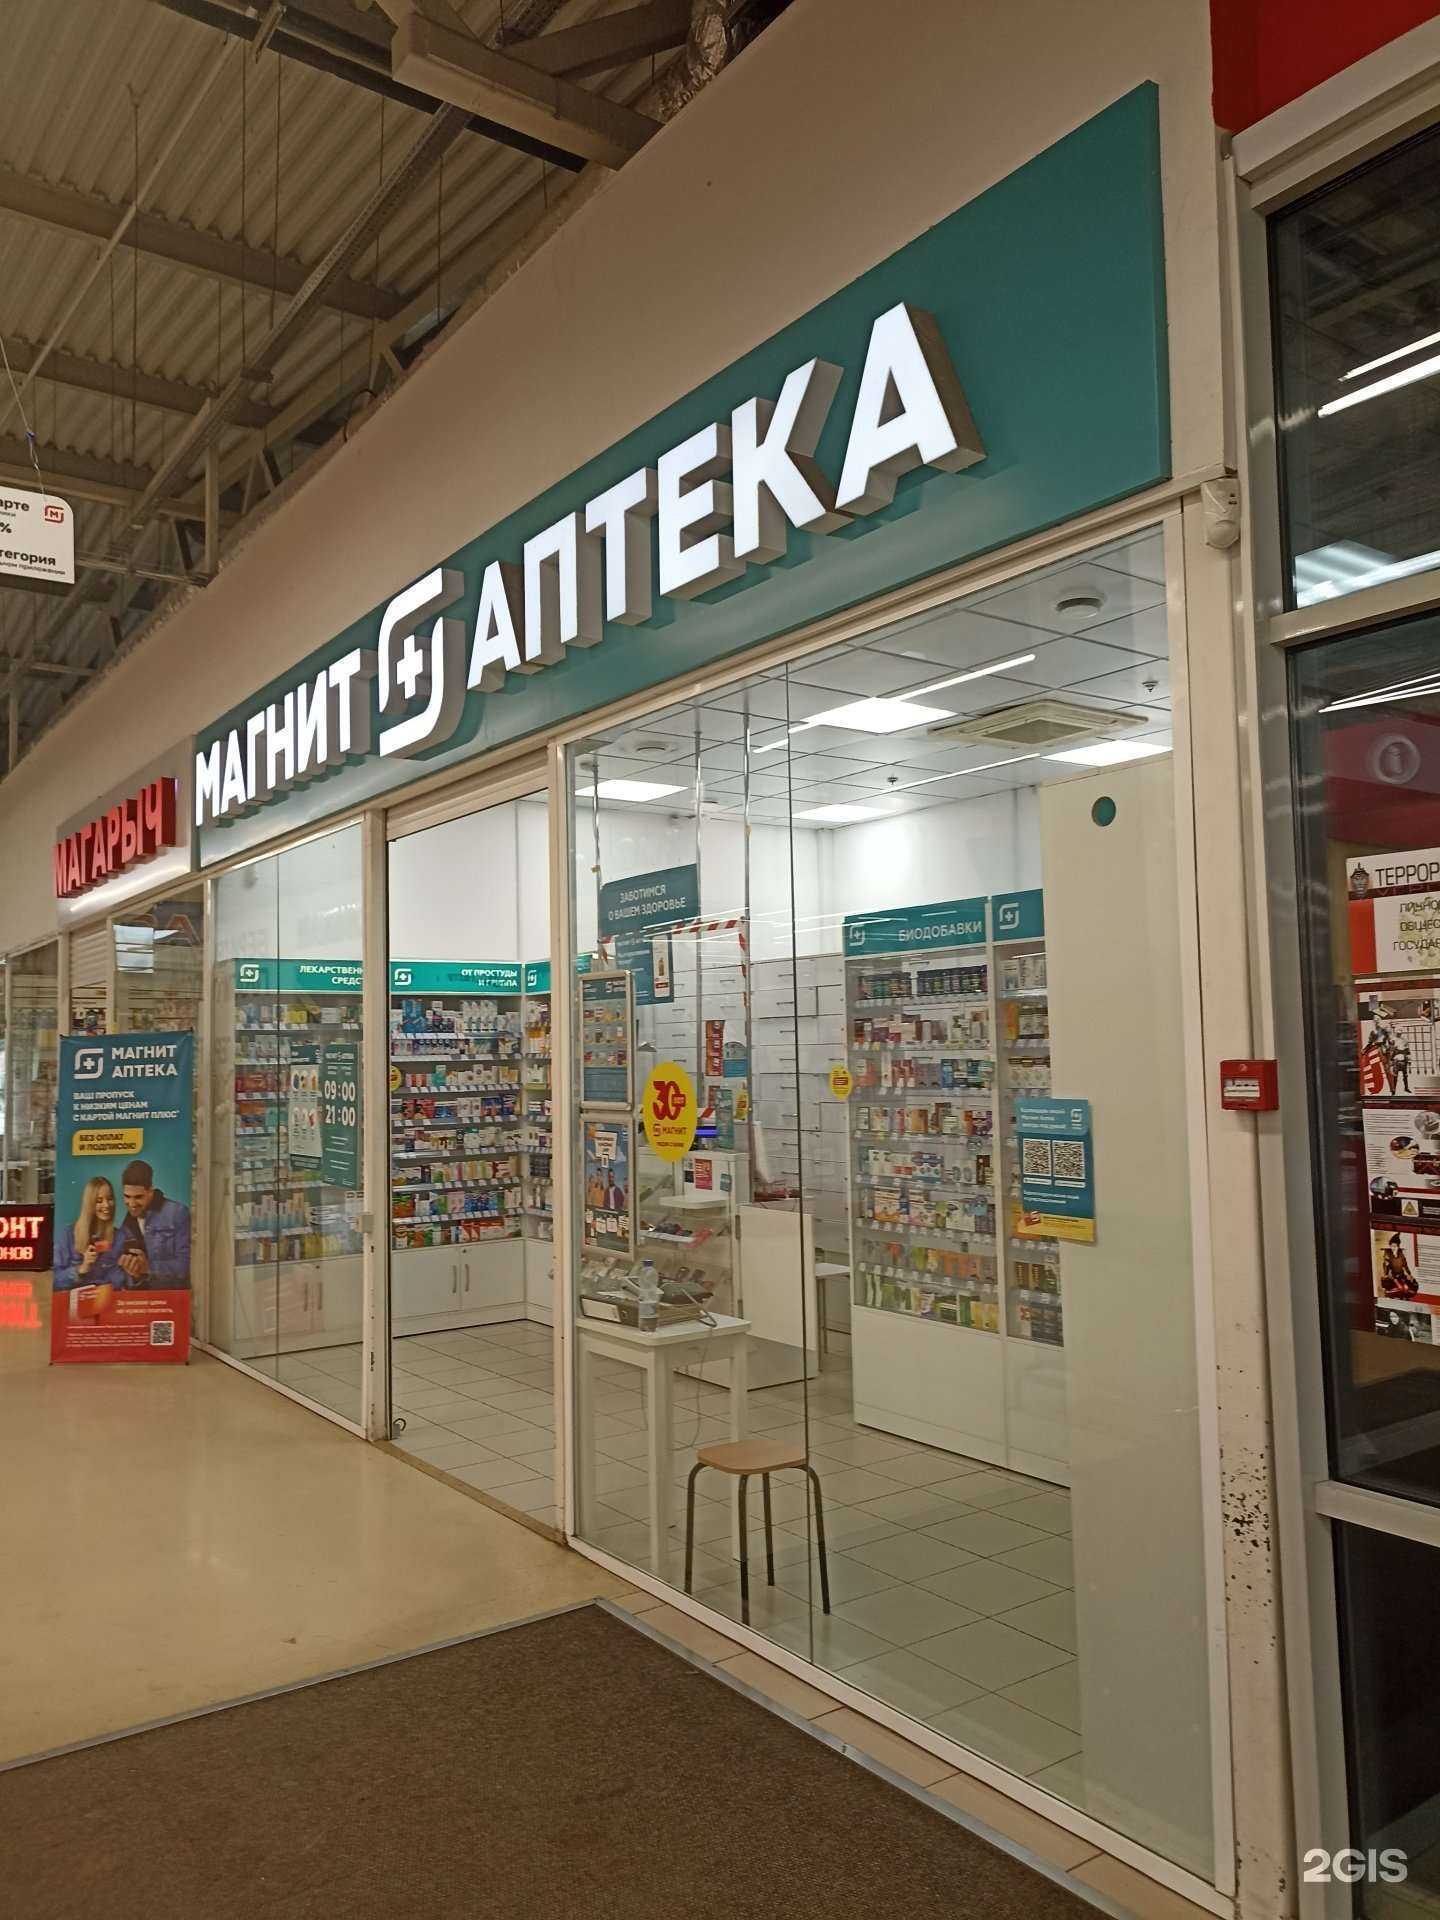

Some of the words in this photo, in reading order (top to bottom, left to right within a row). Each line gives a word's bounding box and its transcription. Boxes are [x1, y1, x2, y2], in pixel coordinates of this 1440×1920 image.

[196, 648, 361, 826] МАГНИТ
[467, 302, 958, 690] АПТЕКА
[54, 777, 164, 896] МАГАРЫЧ
[620, 884, 667, 904] ЗАБОТИМСЯ
[608, 911, 615, 921] О
[641, 897, 687, 916] ЗДОРОВЬЕ
[899, 920, 983, 942] БИОДОБАВКИ
[461, 968, 472, 977] ОТ
[473, 968, 518, 978] ПРОСТУДЫ
[111, 1044, 178, 1060] МАГНИТ
[111, 1063, 179, 1079] АПТЕКА
[95, 1090, 135, 1099] ПРОПУСК
[324, 1080, 356, 1101] 09:00
[80, 1111, 115, 1121] КАРТОЙ
[115, 1111, 150, 1120] МАГНИТ
[325, 1105, 356, 1127] 21:00
